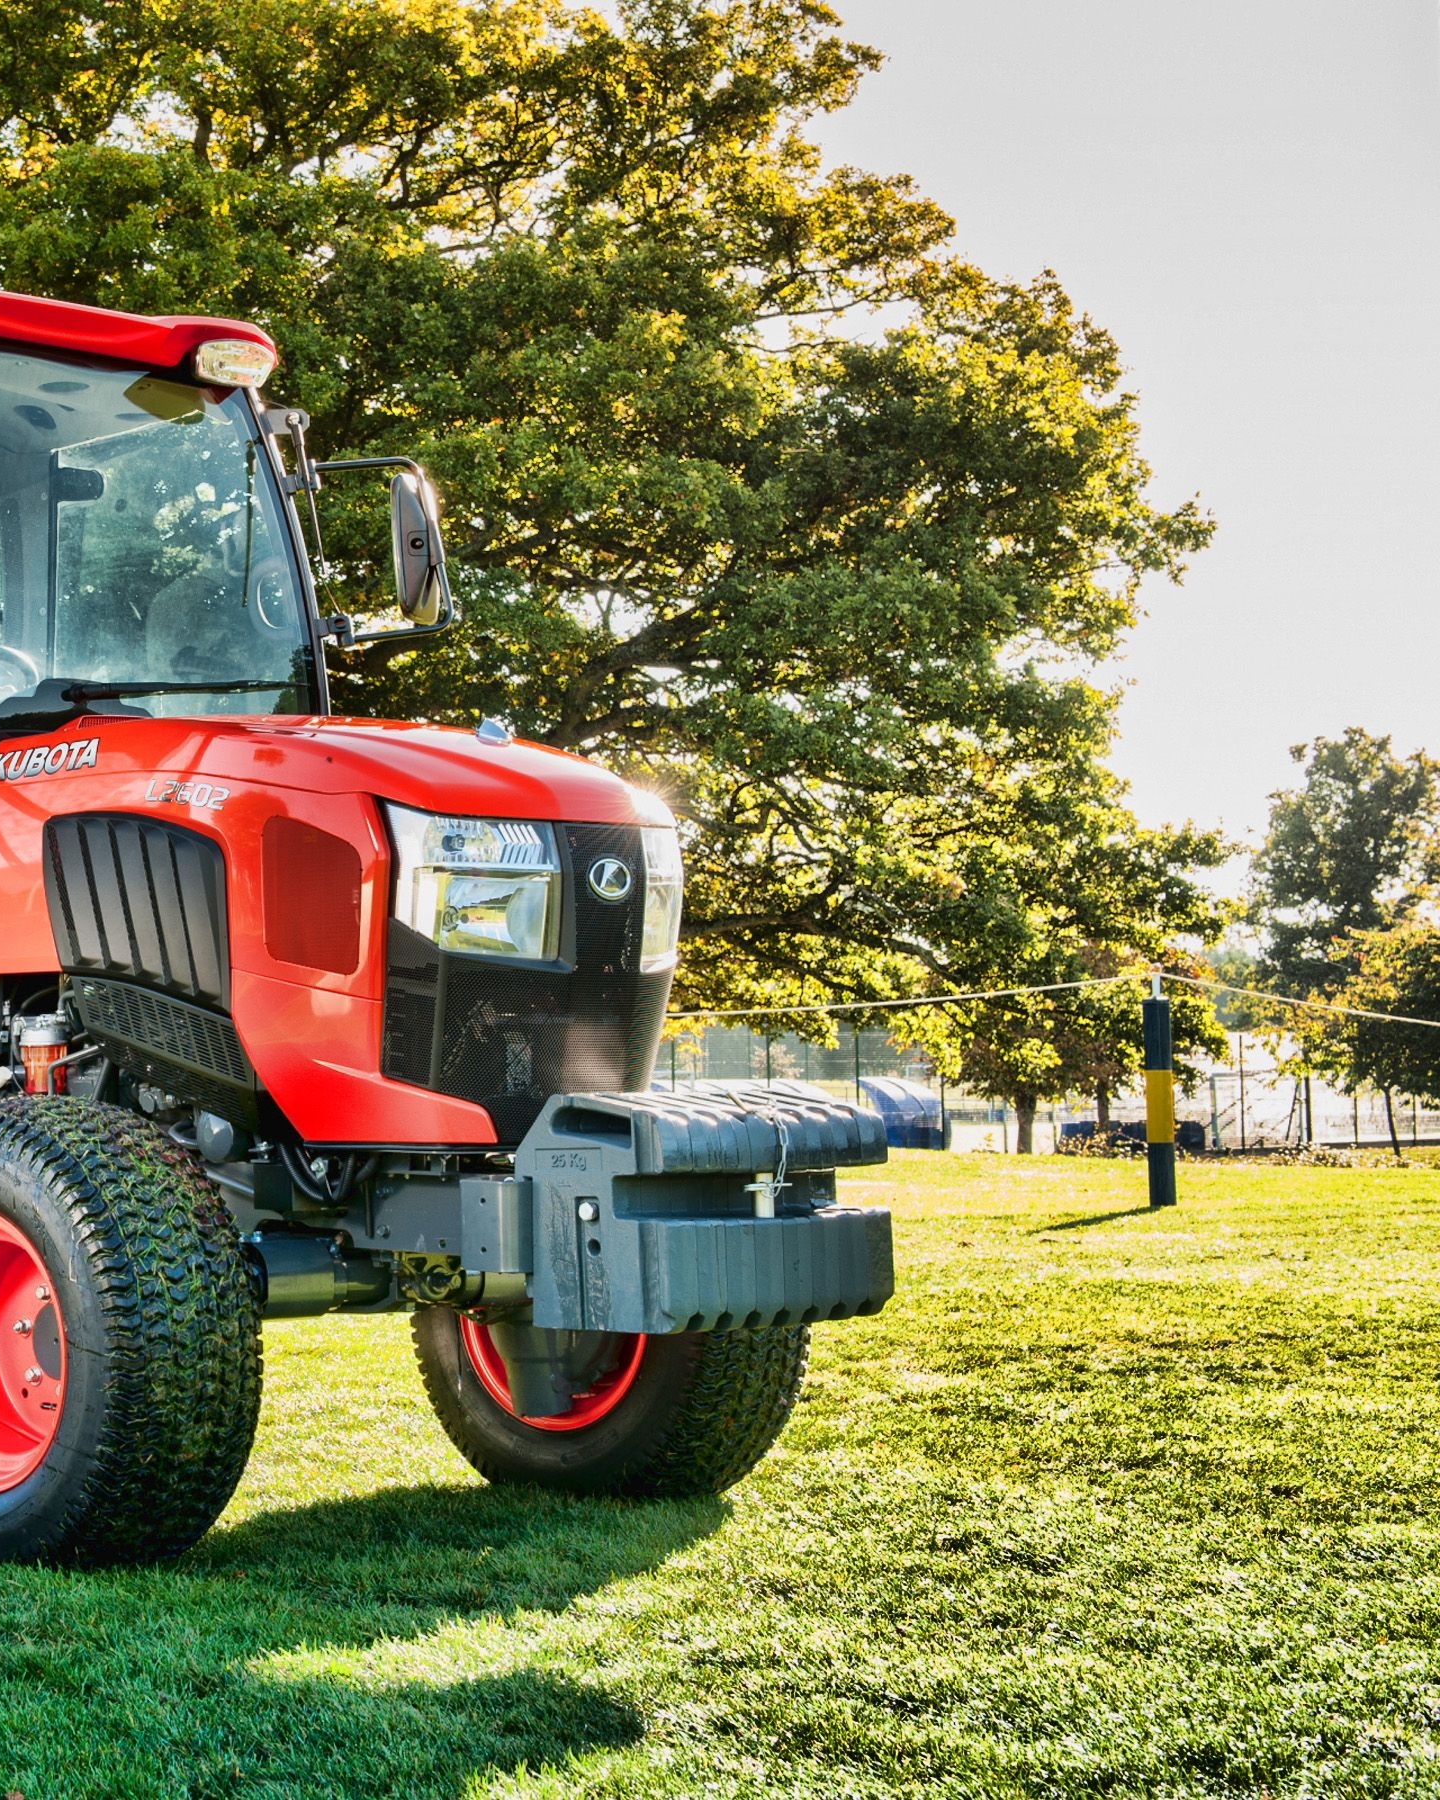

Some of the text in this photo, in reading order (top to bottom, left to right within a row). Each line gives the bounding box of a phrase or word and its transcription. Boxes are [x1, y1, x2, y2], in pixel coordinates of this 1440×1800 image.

[144, 779, 231, 811] L2602
[551, 1153, 587, 1171] 25 Kg
